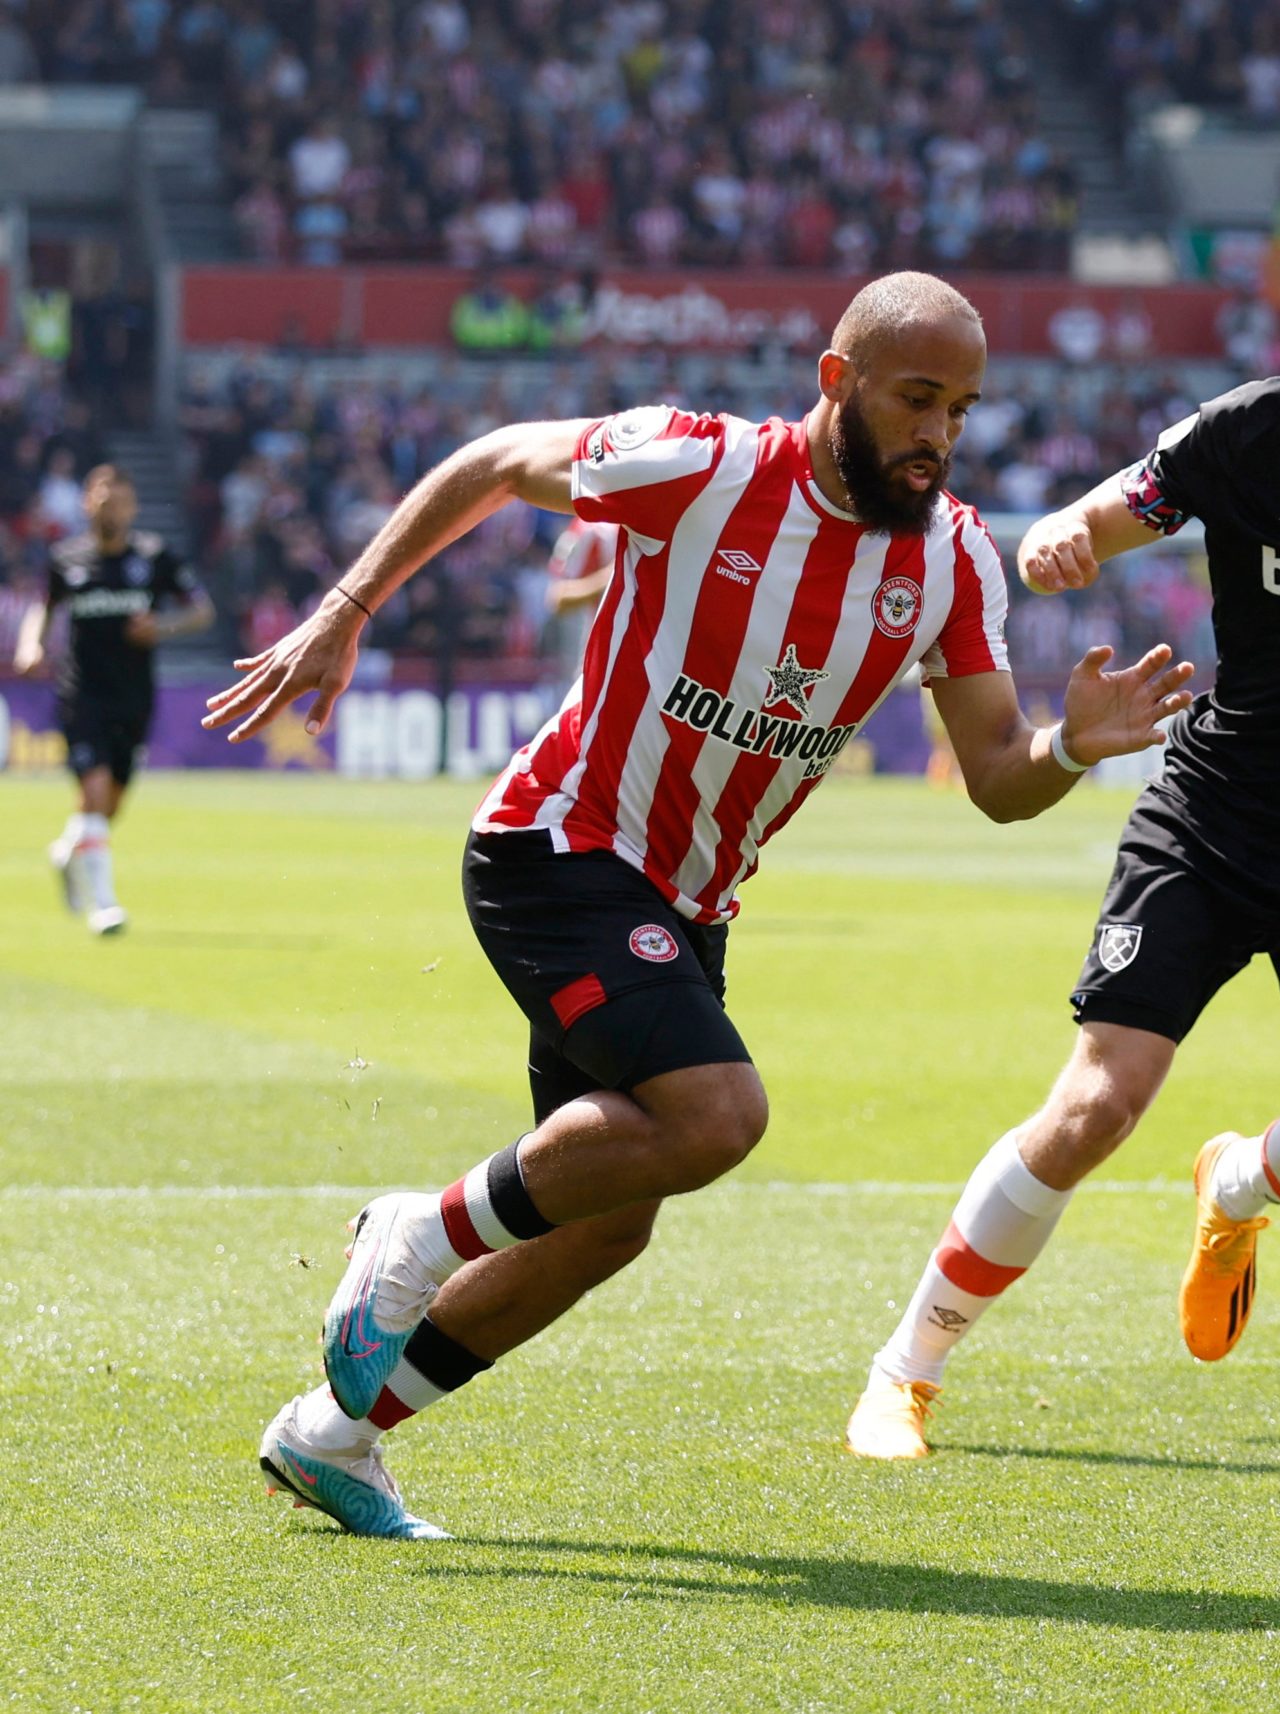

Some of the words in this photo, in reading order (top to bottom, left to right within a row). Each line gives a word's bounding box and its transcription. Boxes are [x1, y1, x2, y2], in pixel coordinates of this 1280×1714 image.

[716, 565, 751, 586] umbro
[882, 580, 919, 598] BRENTFORD
[660, 674, 857, 761] HOLLYWOOD
